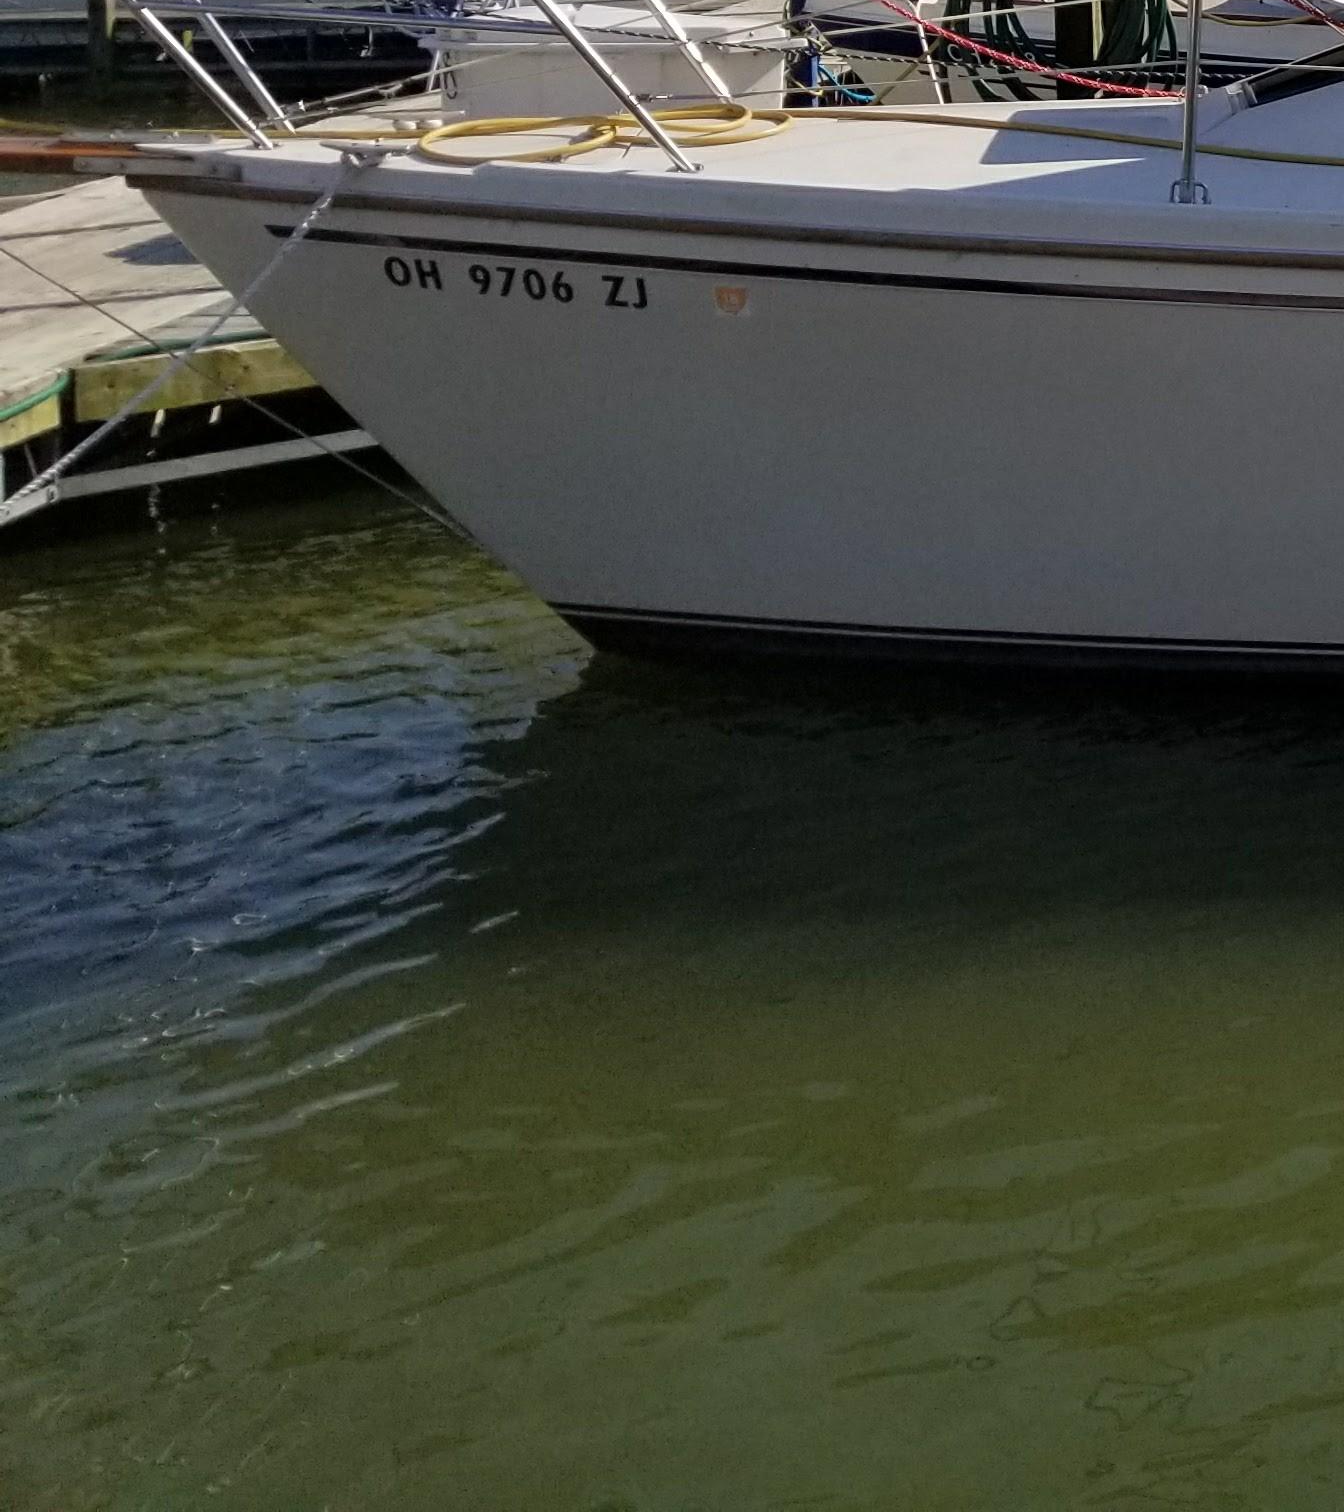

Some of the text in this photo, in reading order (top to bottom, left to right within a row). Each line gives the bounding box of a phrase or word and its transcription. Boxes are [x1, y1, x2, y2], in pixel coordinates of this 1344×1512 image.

[384, 255, 648, 309] OH 9706 ZJ
